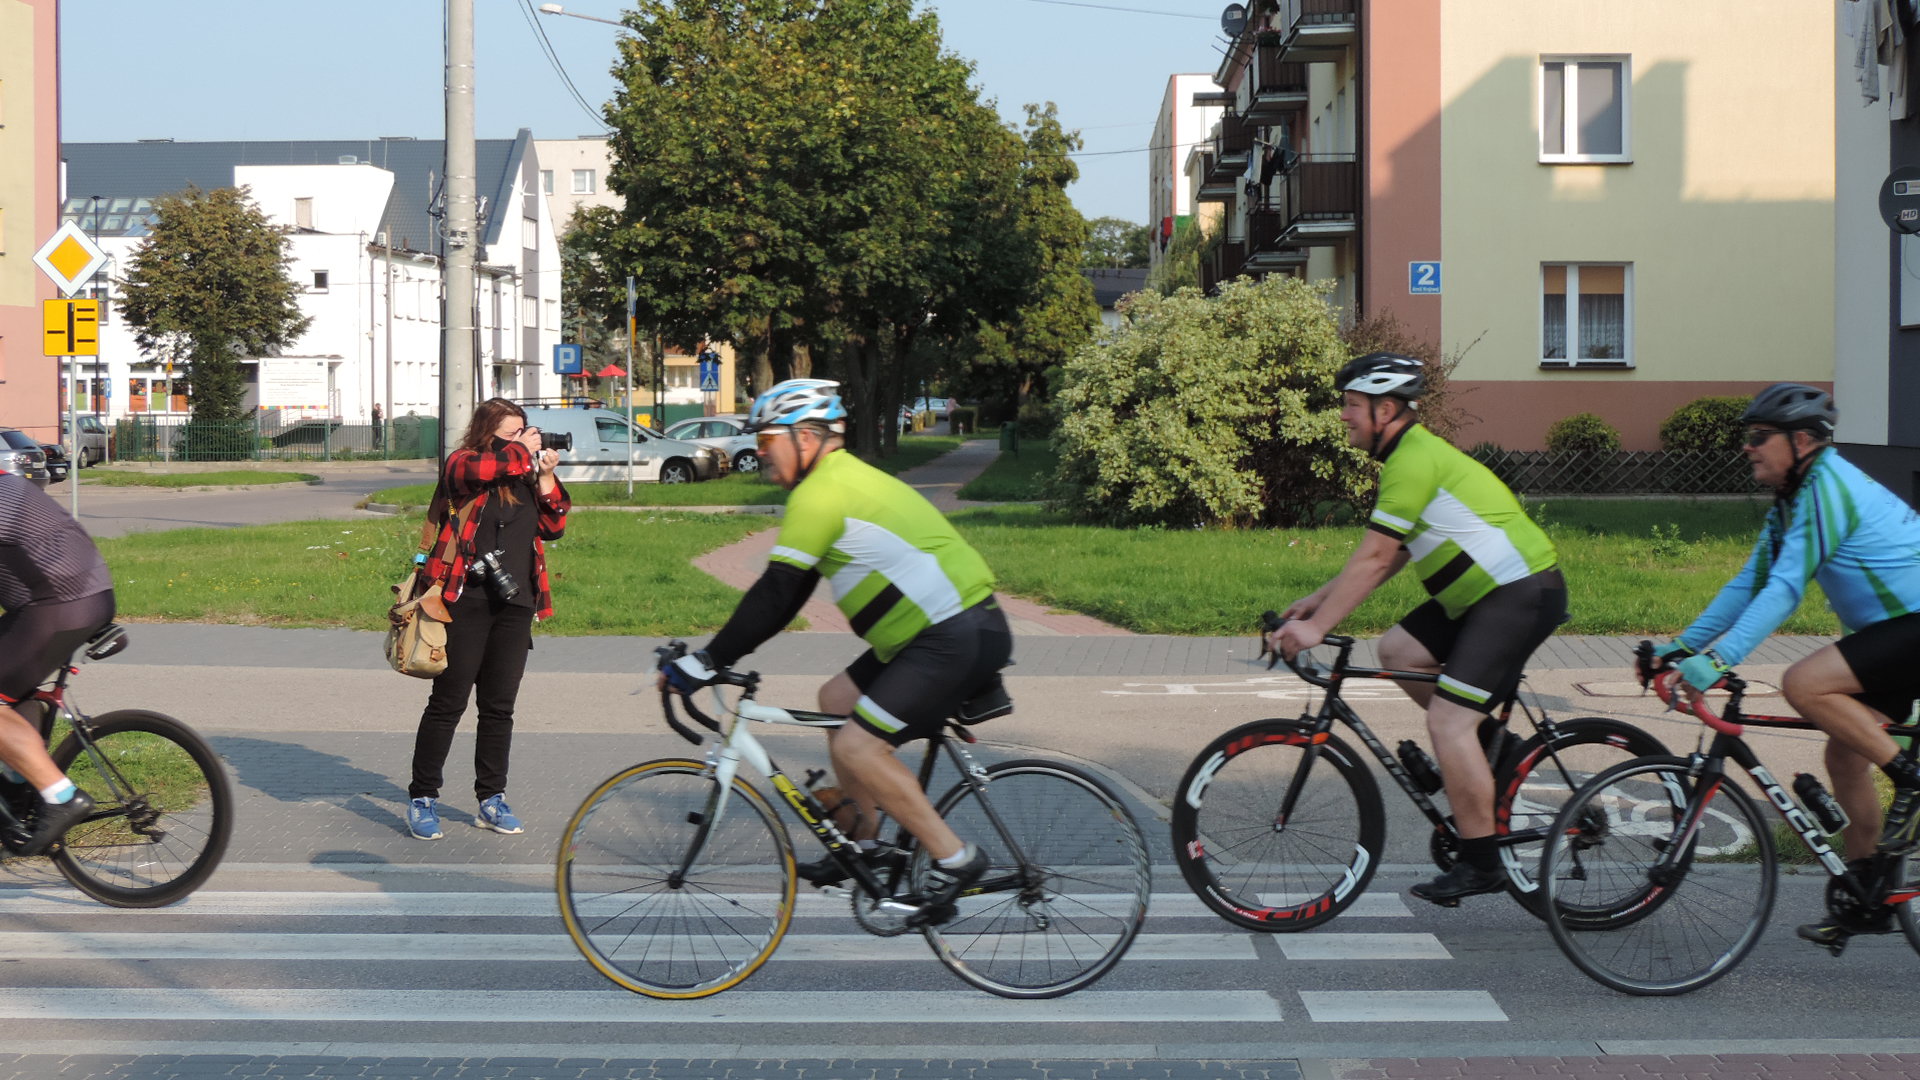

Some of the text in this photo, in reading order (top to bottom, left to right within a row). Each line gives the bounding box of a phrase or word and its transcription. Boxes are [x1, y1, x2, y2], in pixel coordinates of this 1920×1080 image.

[1902, 211, 1917, 220] HD
[1417, 264, 1434, 285] 2
[559, 347, 576, 371] P
[1749, 765, 1849, 876] FOCUS
